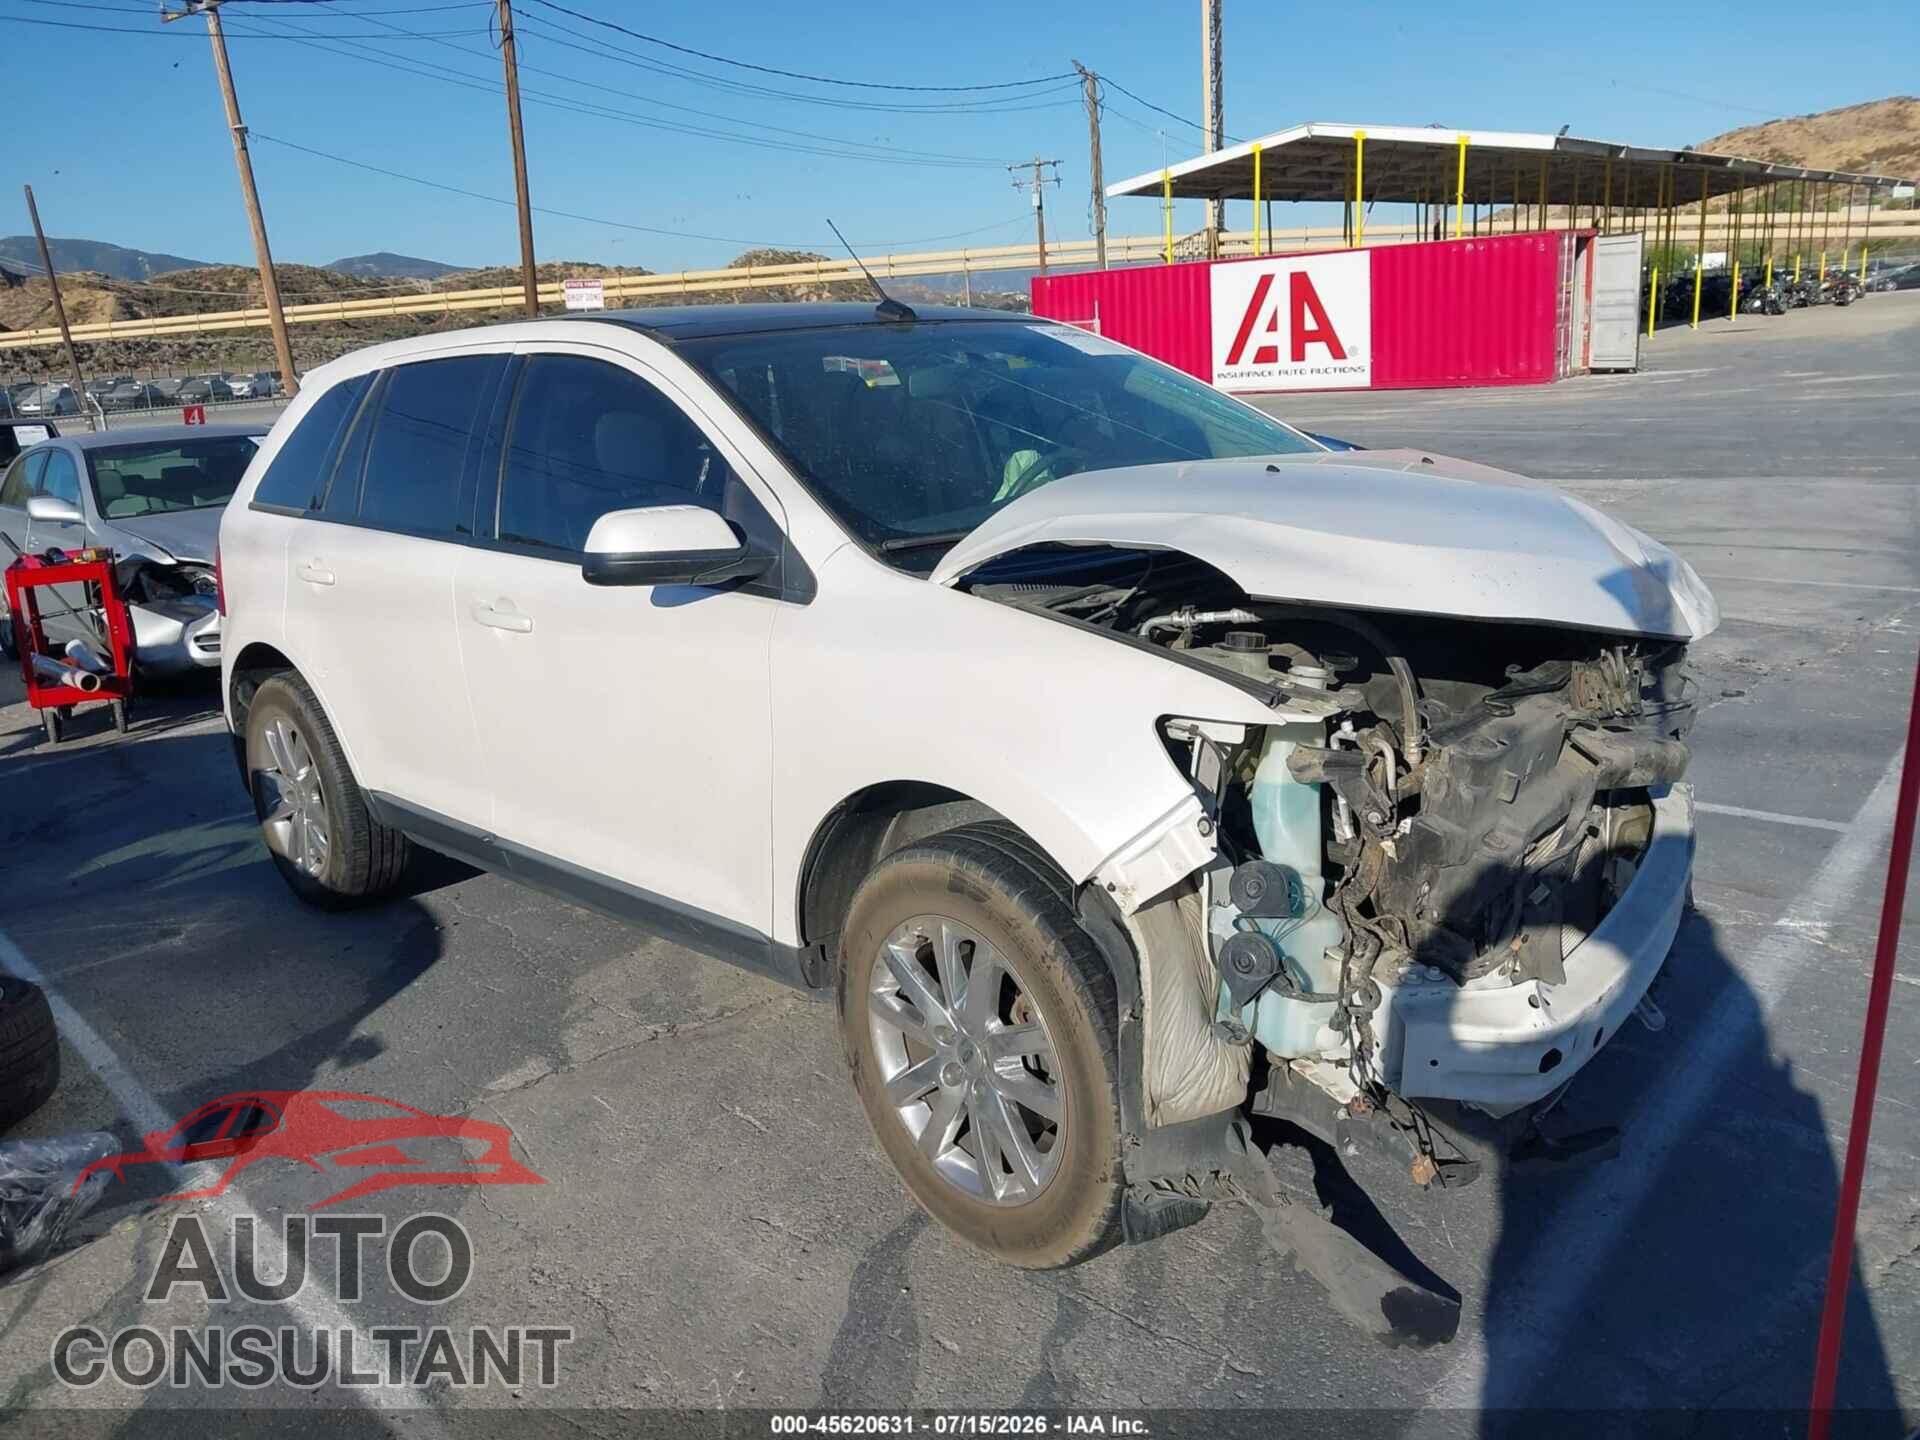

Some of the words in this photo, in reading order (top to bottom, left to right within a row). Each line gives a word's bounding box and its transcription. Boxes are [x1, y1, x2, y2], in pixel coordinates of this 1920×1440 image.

[1217, 369, 1275, 380] INSURANCE
[1278, 367, 1307, 377] AUTO
[1310, 365, 1366, 376] AUCTIONS
[188, 406, 201, 424] 4
